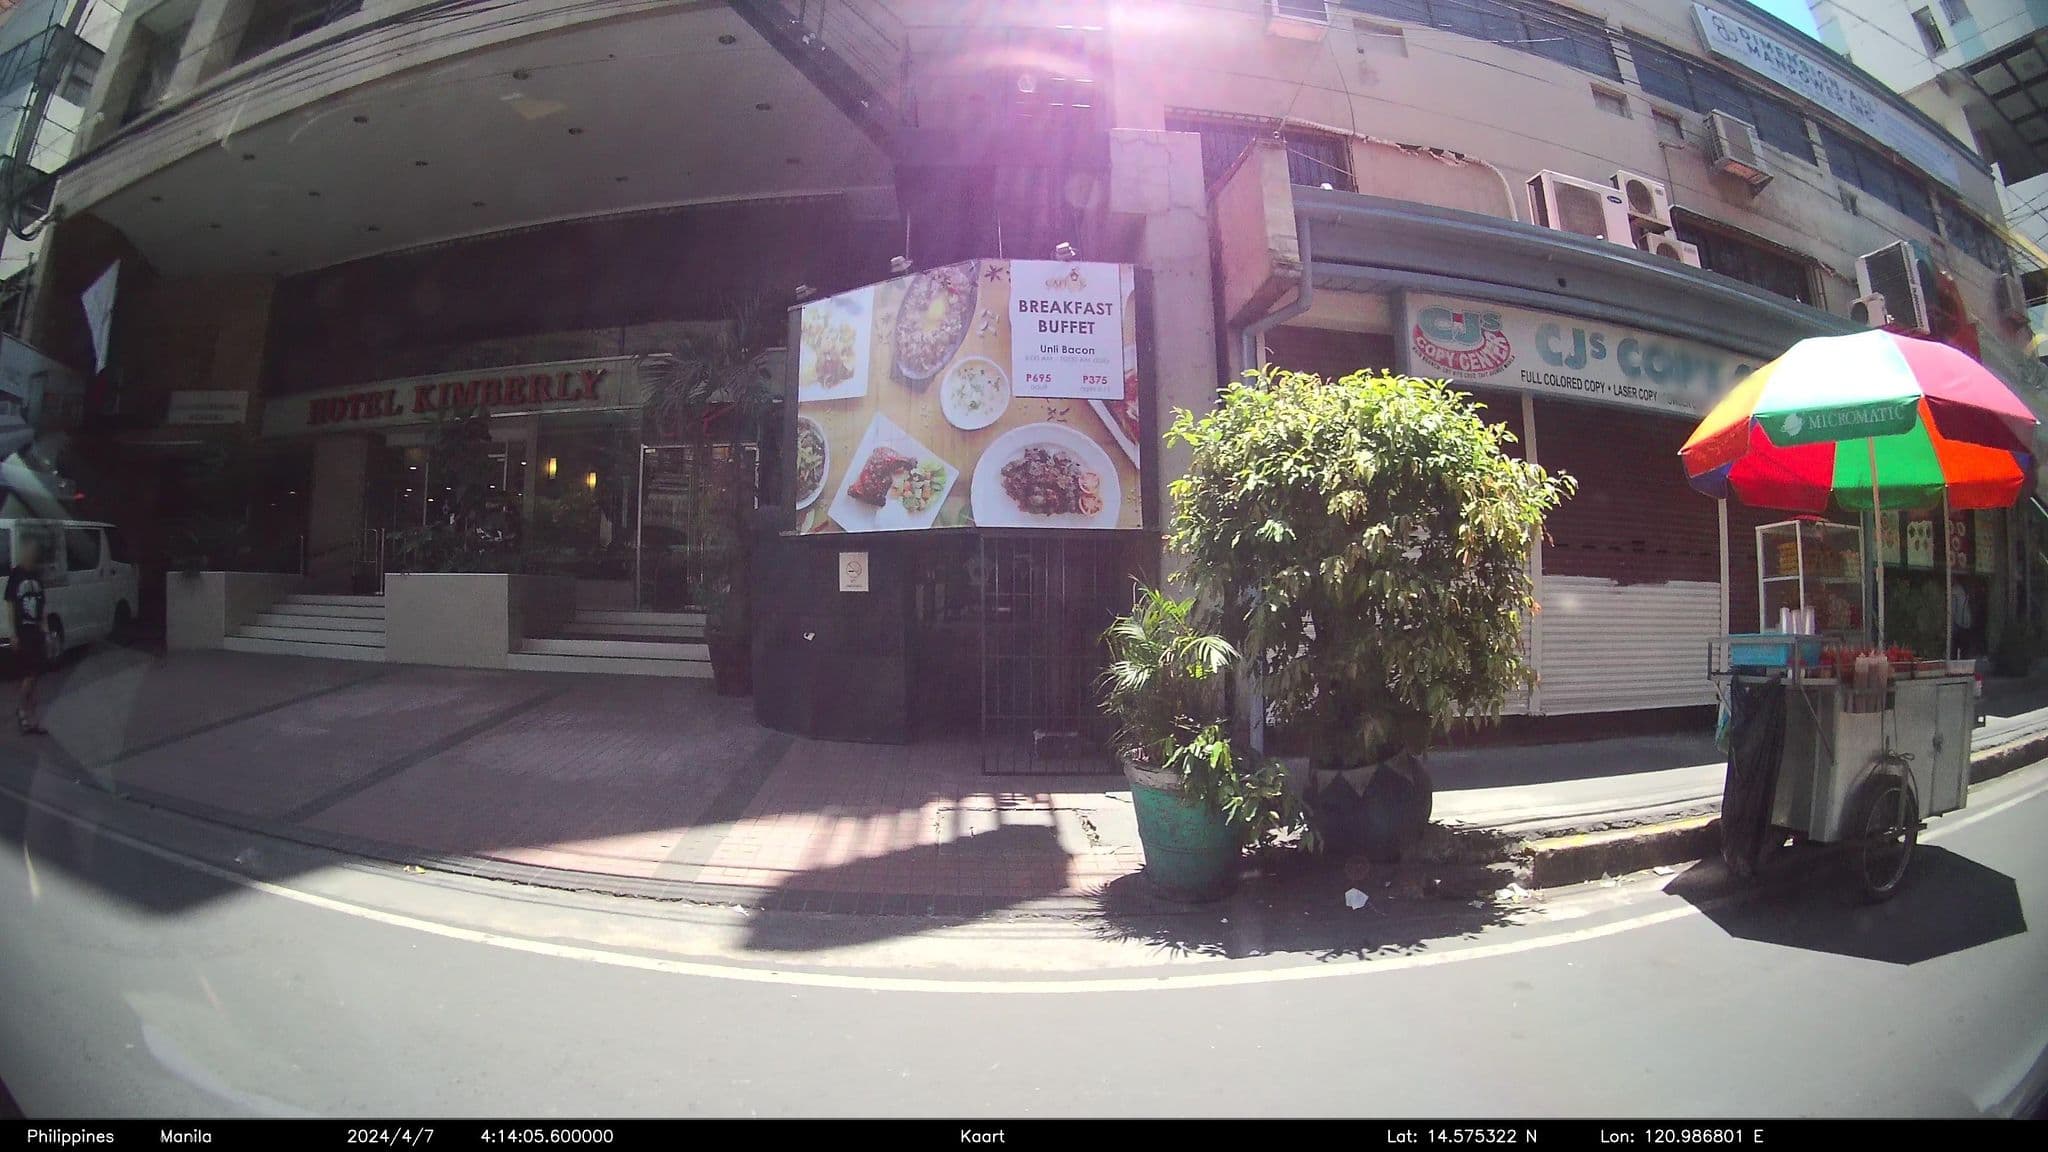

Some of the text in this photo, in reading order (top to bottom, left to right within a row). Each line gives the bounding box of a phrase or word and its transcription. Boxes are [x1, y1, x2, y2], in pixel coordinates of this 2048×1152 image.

[1746, 42, 1845, 102] MANPOWER
[1018, 299, 1113, 316] BREAKFAST
[1038, 319, 1096, 335] BUFFET
[1040, 345, 1095, 355] Unli Bacon
[1415, 335, 1454, 369] COPY
[306, 368, 607, 425] HOTEL KIMBERLY
[1520, 369, 1658, 402] FULL COLORED COPY LASER COPY
[1808, 405, 1906, 430] MICROMATIC
